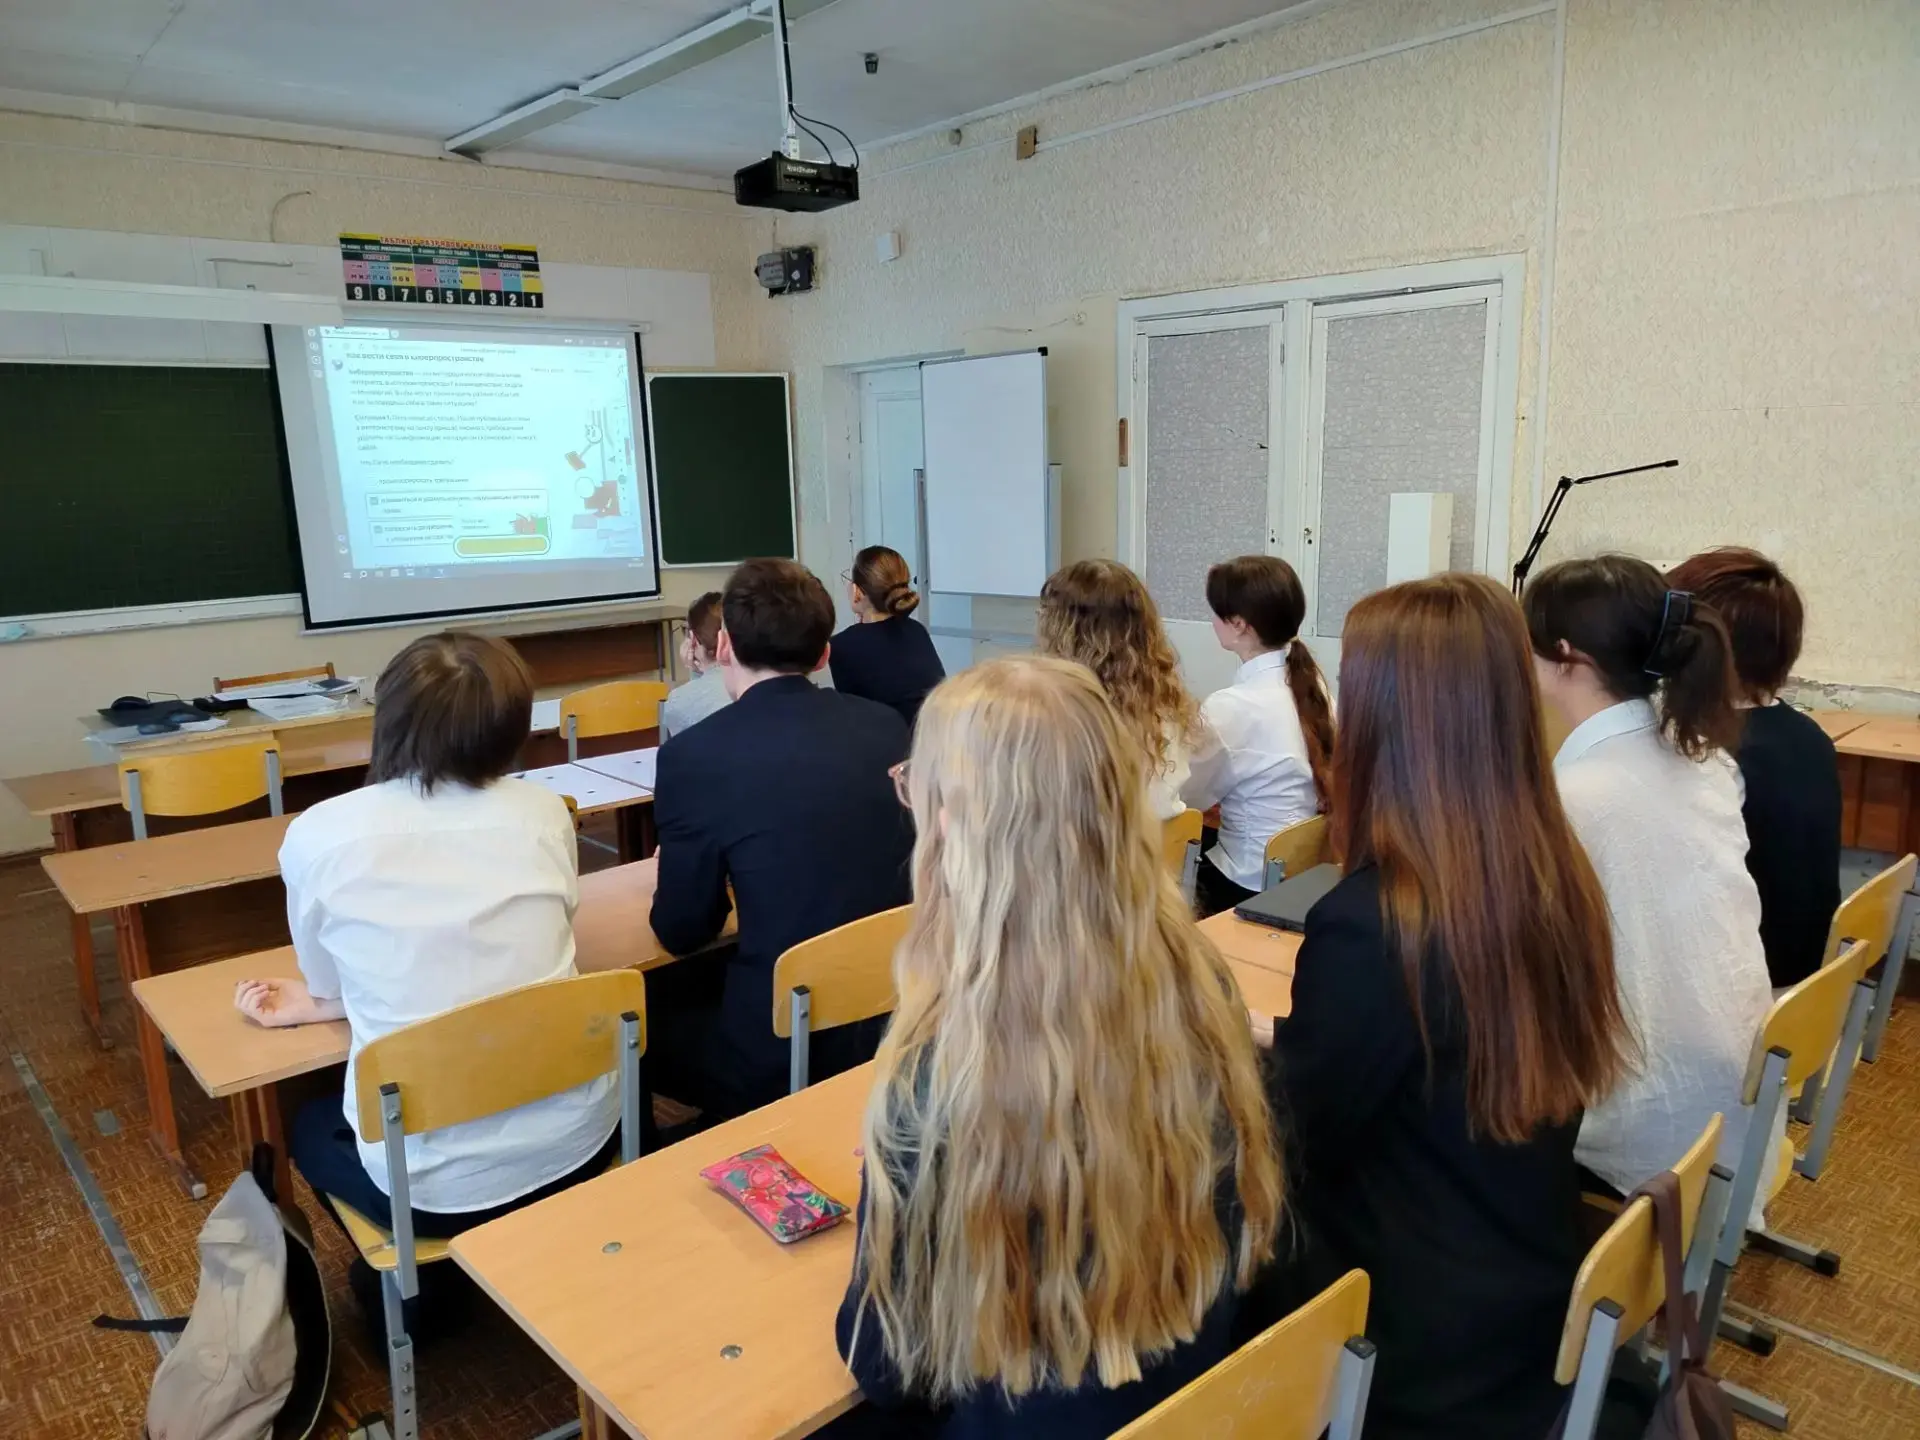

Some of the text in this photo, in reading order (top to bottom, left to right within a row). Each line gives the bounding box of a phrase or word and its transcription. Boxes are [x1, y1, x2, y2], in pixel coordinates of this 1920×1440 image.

[354, 286, 363, 300] 9
[377, 287, 387, 301] 8
[401, 288, 410, 302] 7
[425, 289, 434, 303] 6
[446, 290, 454, 304] 5
[468, 291, 476, 305] 4
[489, 292, 497, 306] 3
[509, 293, 517, 307] 2
[530, 294, 537, 308] 1
